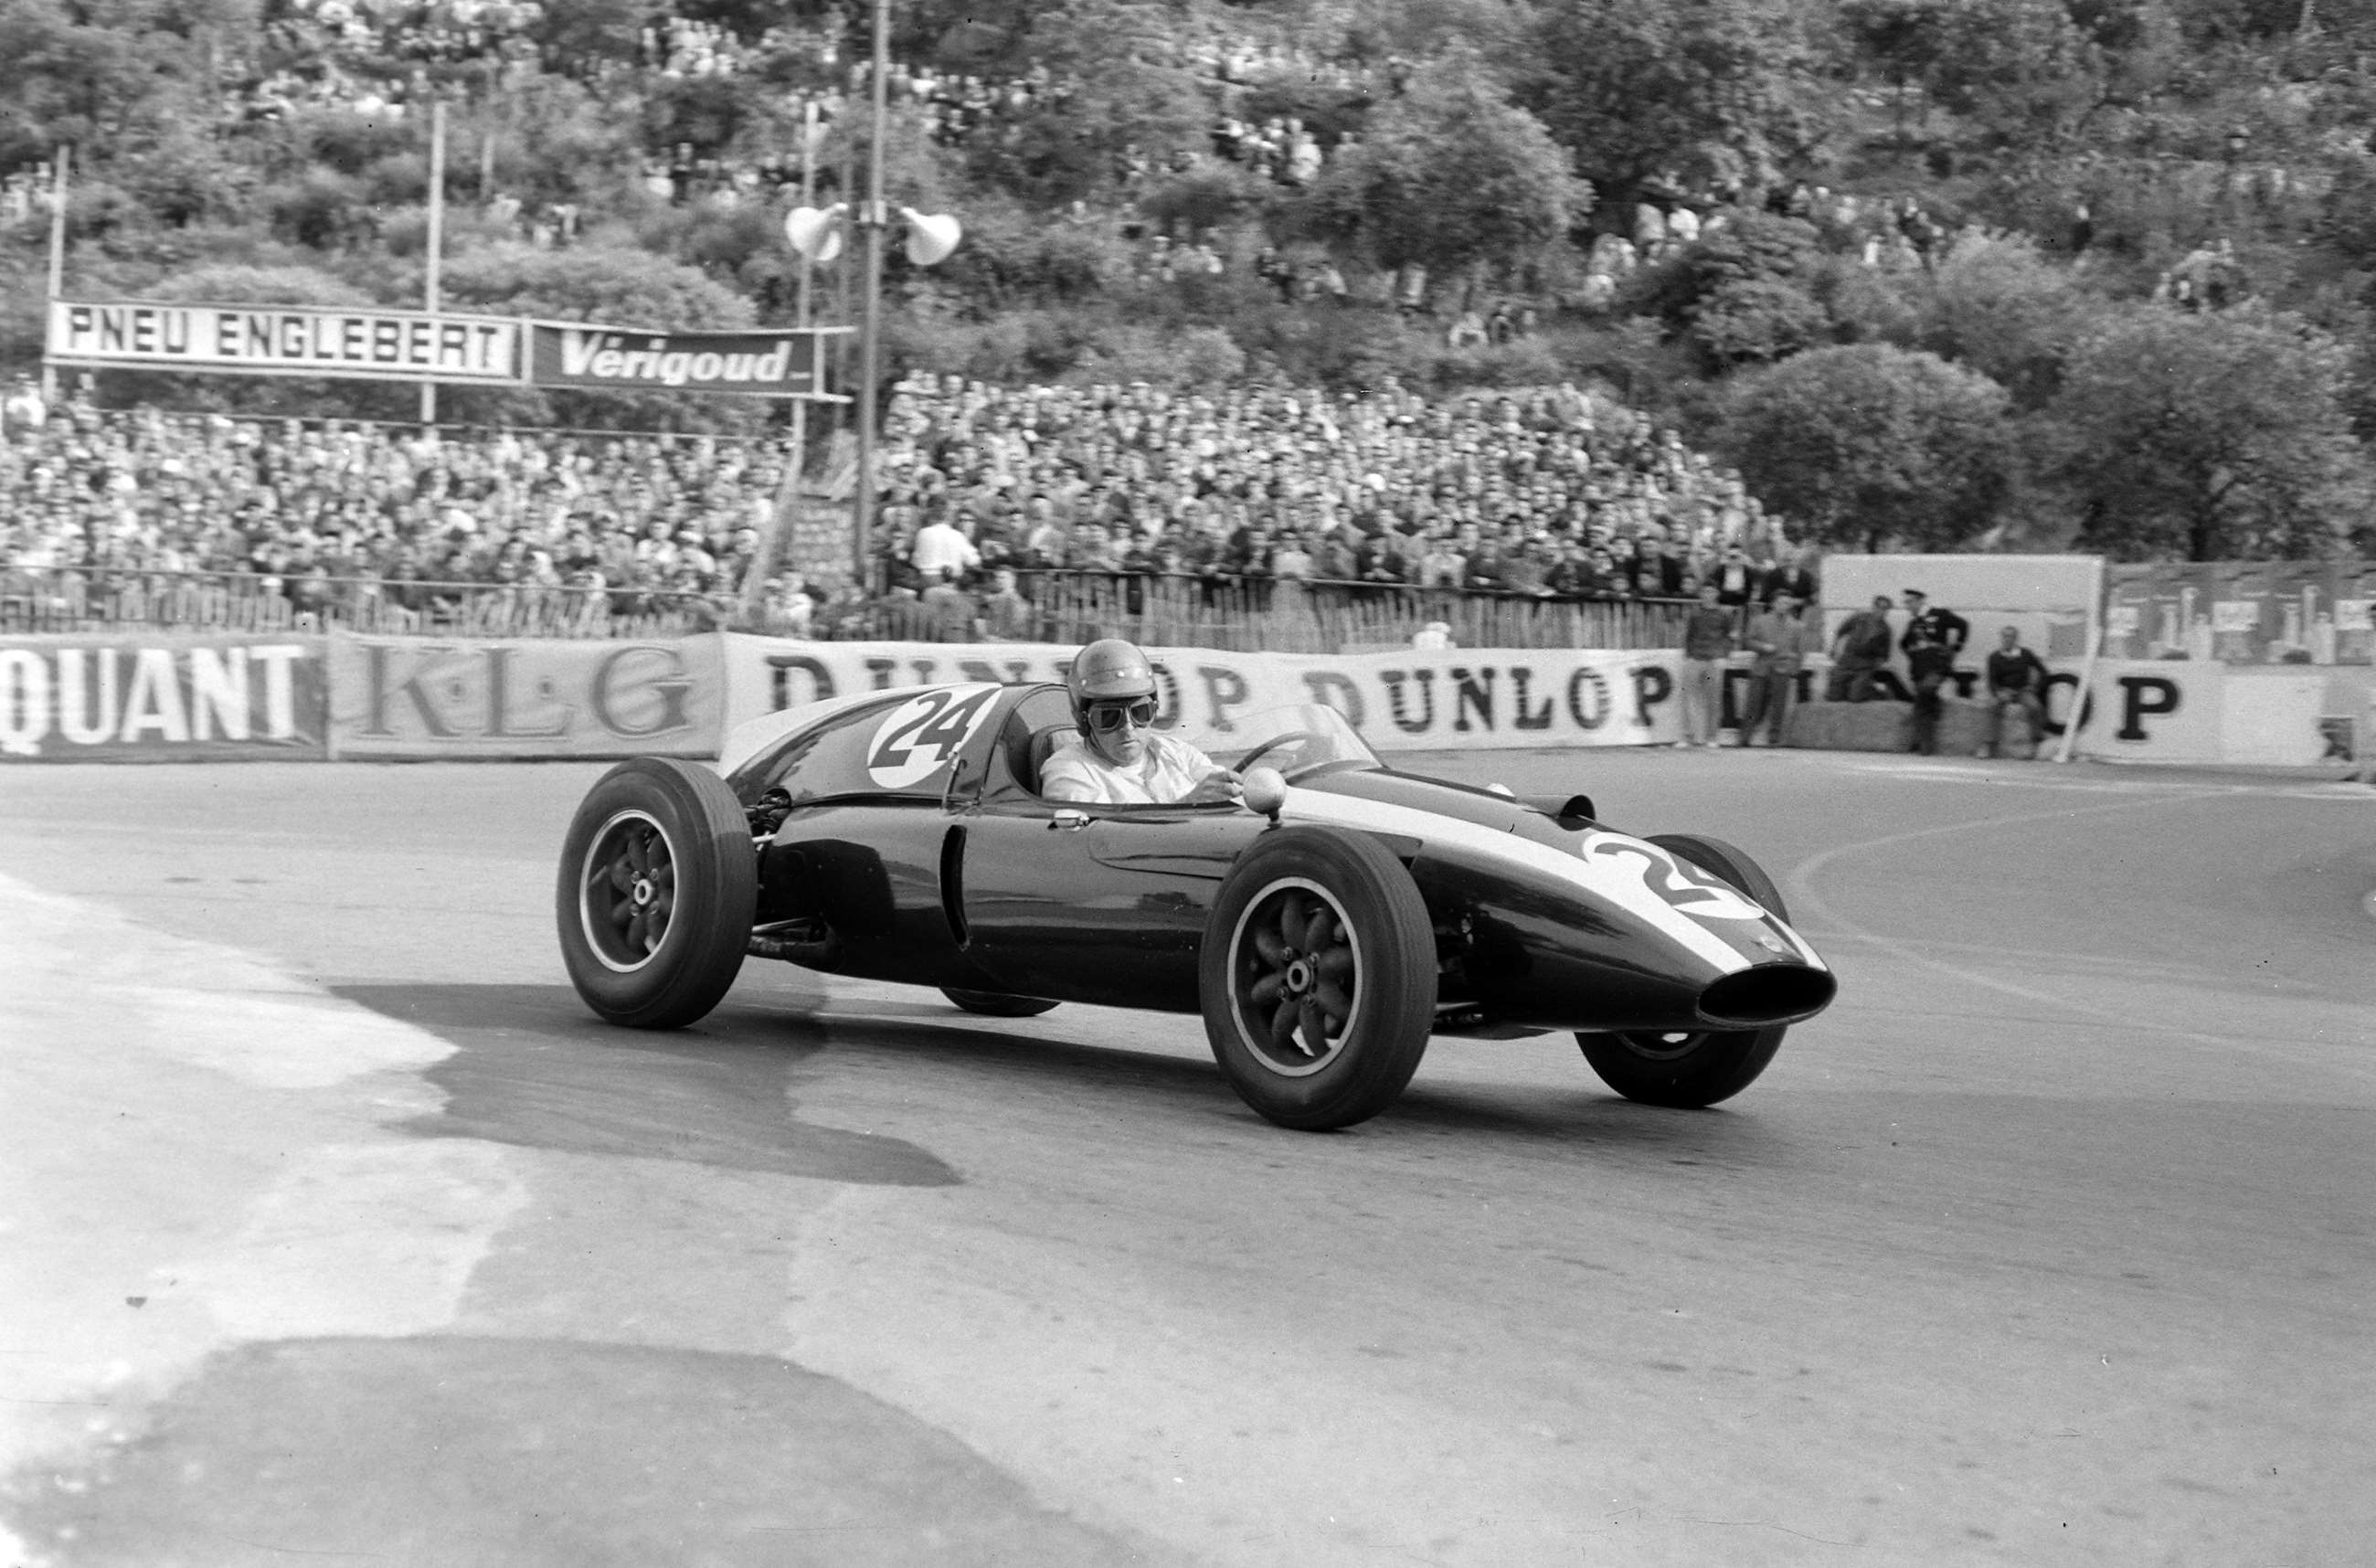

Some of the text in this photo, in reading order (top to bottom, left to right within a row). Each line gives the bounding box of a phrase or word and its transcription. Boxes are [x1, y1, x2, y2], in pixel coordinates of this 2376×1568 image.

[69, 306, 498, 367] PNEU ENGLEBERT
[560, 330, 793, 386] Vérigoud
[0, 644, 305, 756] QUANT
[869, 687, 1002, 768] 24
[1301, 667, 1673, 732] DUNLOP
